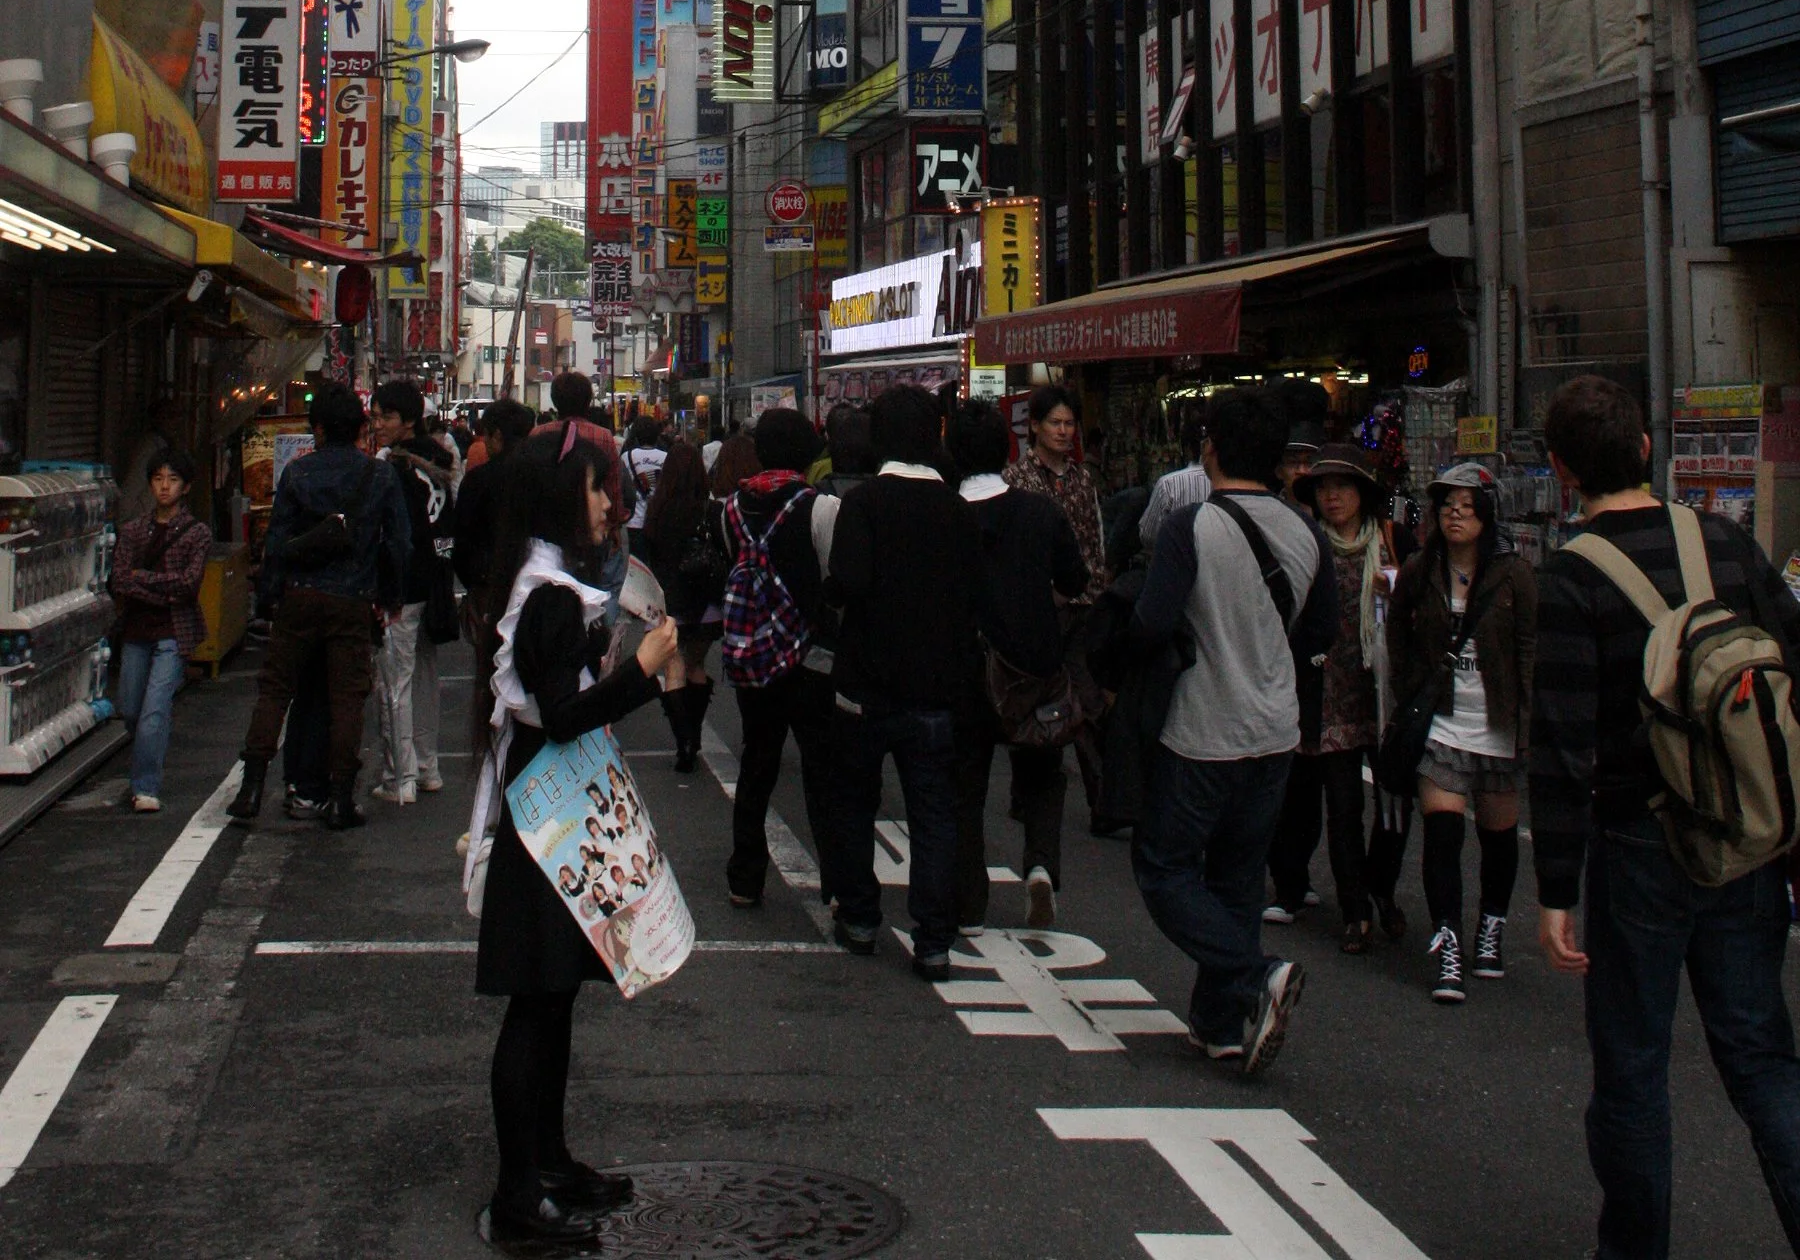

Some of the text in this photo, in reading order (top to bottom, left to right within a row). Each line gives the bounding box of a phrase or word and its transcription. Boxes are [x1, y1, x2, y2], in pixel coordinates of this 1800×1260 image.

[699, 157, 726, 166] SHOP
[597, 133, 633, 215] 本店
[702, 171, 724, 185] 4F
[916, 143, 983, 197] アニメ
[221, 174, 293, 190] 通信販売
[699, 201, 727, 215] ネジ
[774, 196, 803, 211] 消火栓
[707, 217, 718, 227] の
[1001, 212, 1021, 313] ミニカー
[698, 281, 728, 298] ネジ
[829, 291, 876, 330] PACHINKO
[886, 281, 918, 318] SLOT
[1408, 352, 1429, 373] OPEN
